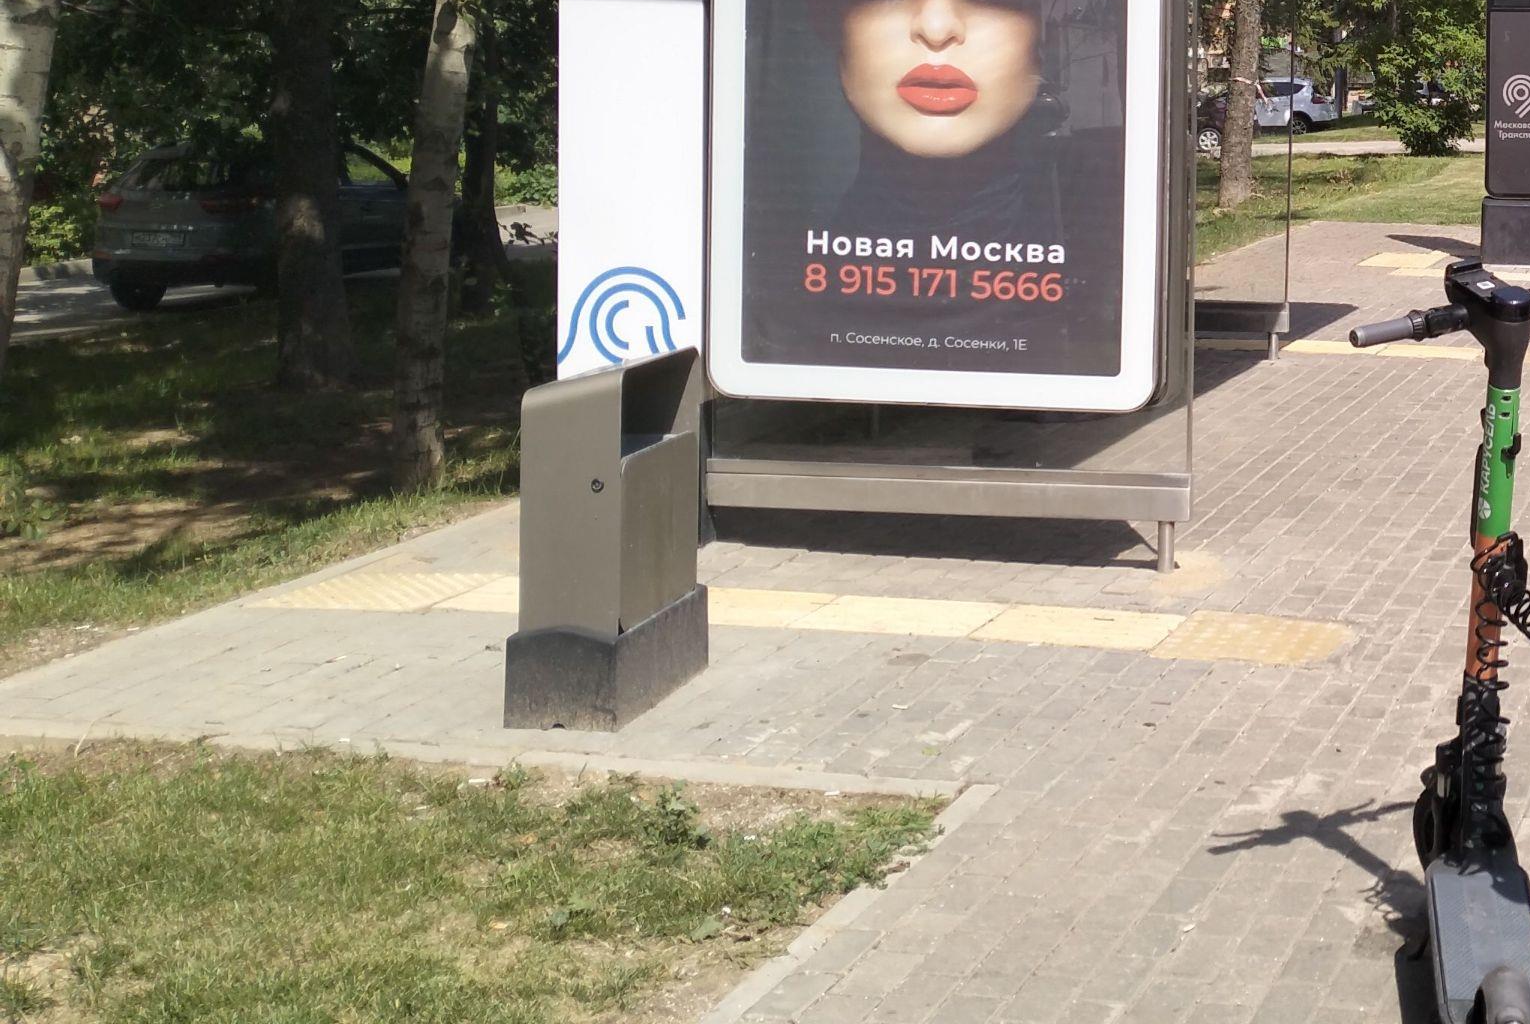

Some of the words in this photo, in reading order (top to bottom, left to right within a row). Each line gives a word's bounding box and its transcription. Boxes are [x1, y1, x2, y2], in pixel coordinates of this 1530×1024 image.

[806, 229, 914, 258] Новая
[930, 235, 1066, 264] Москва
[804, 262, 827, 292] 8
[838, 264, 897, 296] 915
[908, 267, 958, 298] 171
[970, 270, 1063, 303] 5666
[830, 333, 842, 343] п.
[845, 332, 925, 348] Сосенское,
[927, 336, 941, 349] д.
[944, 336, 1010, 352] Сосенки,
[1480, 403, 1496, 494] КАРУСЕЛЬ
